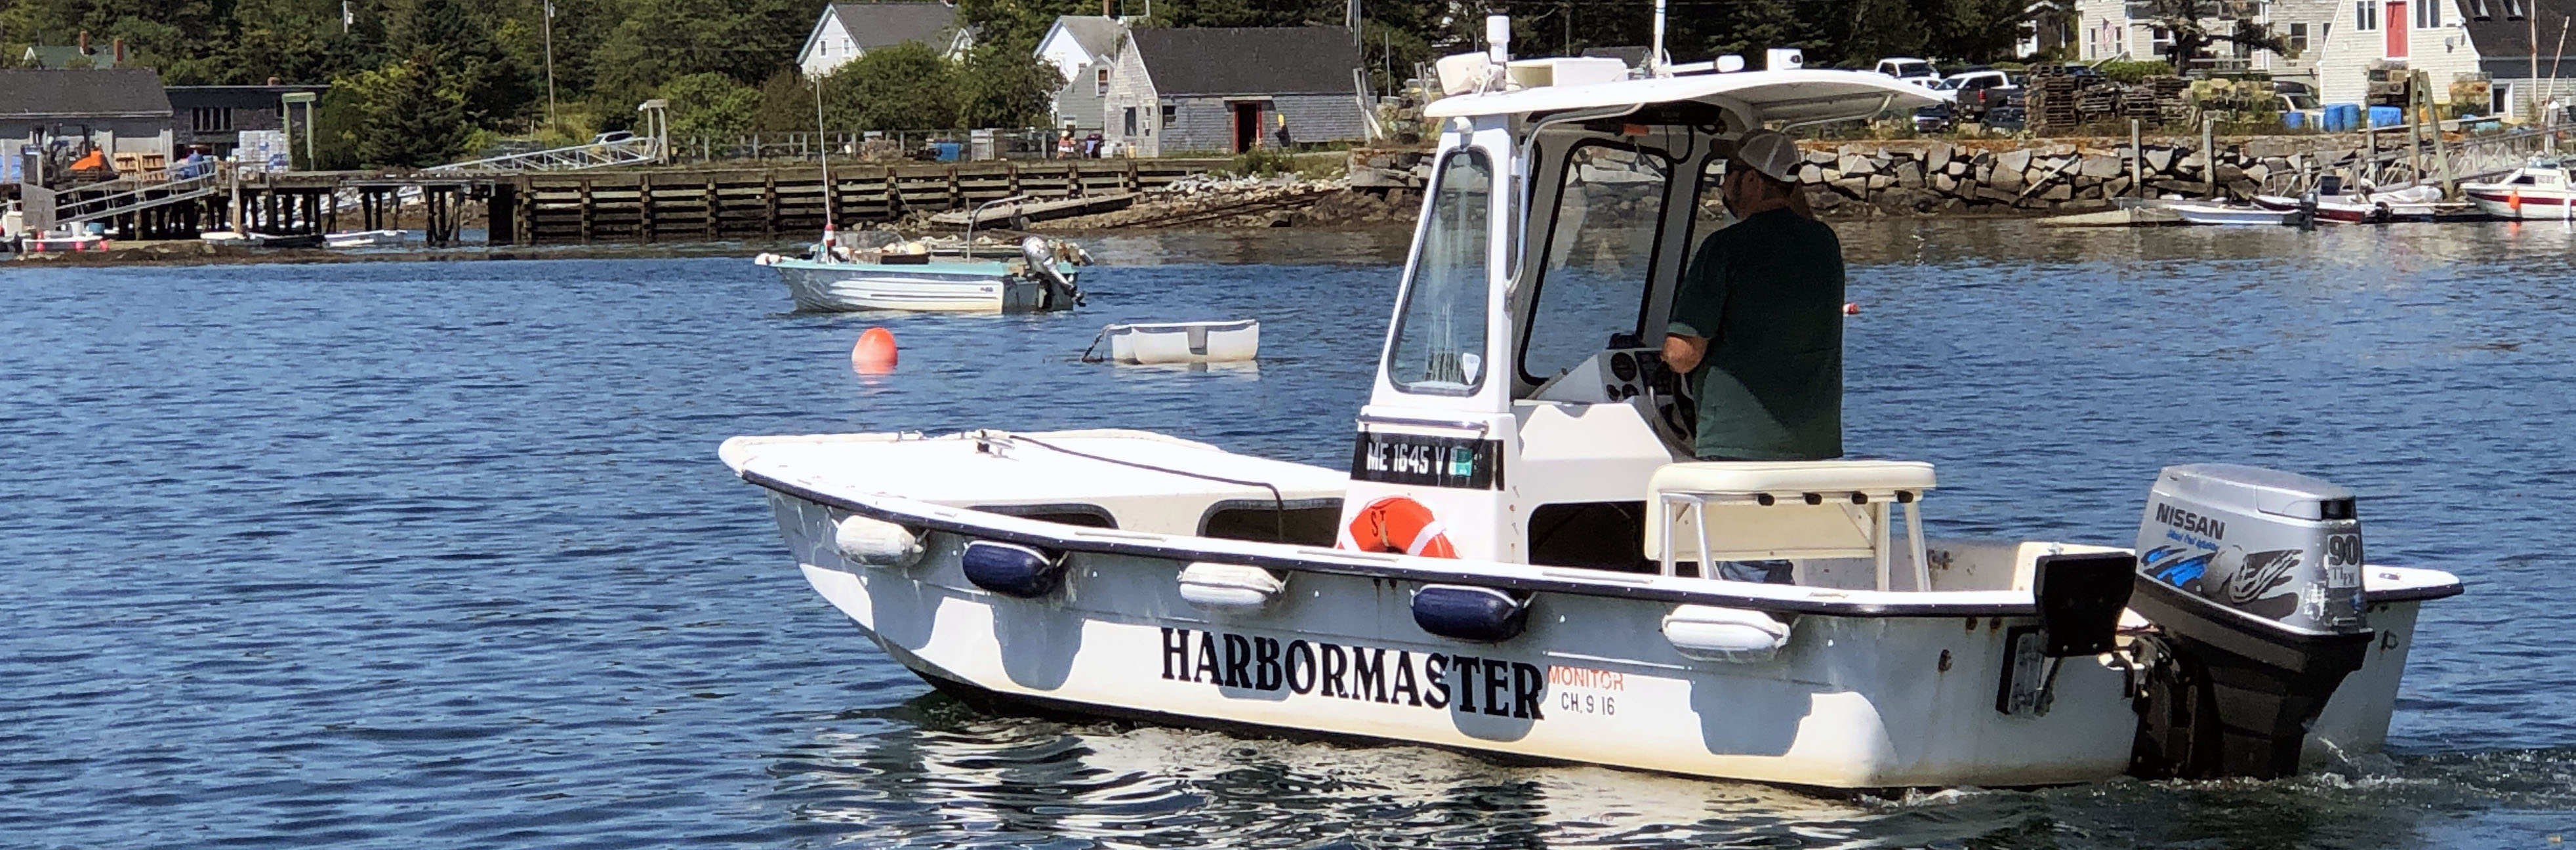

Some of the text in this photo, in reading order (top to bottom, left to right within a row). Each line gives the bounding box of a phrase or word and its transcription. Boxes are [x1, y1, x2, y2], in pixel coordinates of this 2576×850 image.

[1366, 442, 1389, 471] ME
[1393, 443, 1429, 474] 1645
[2156, 502, 2226, 540] NISSAN
[2329, 535, 2360, 565] 90
[1160, 627, 1544, 720] HARBORMASTER
[1547, 664, 1624, 691] MONITOR
[1561, 692, 1615, 716] CH. 9 16
